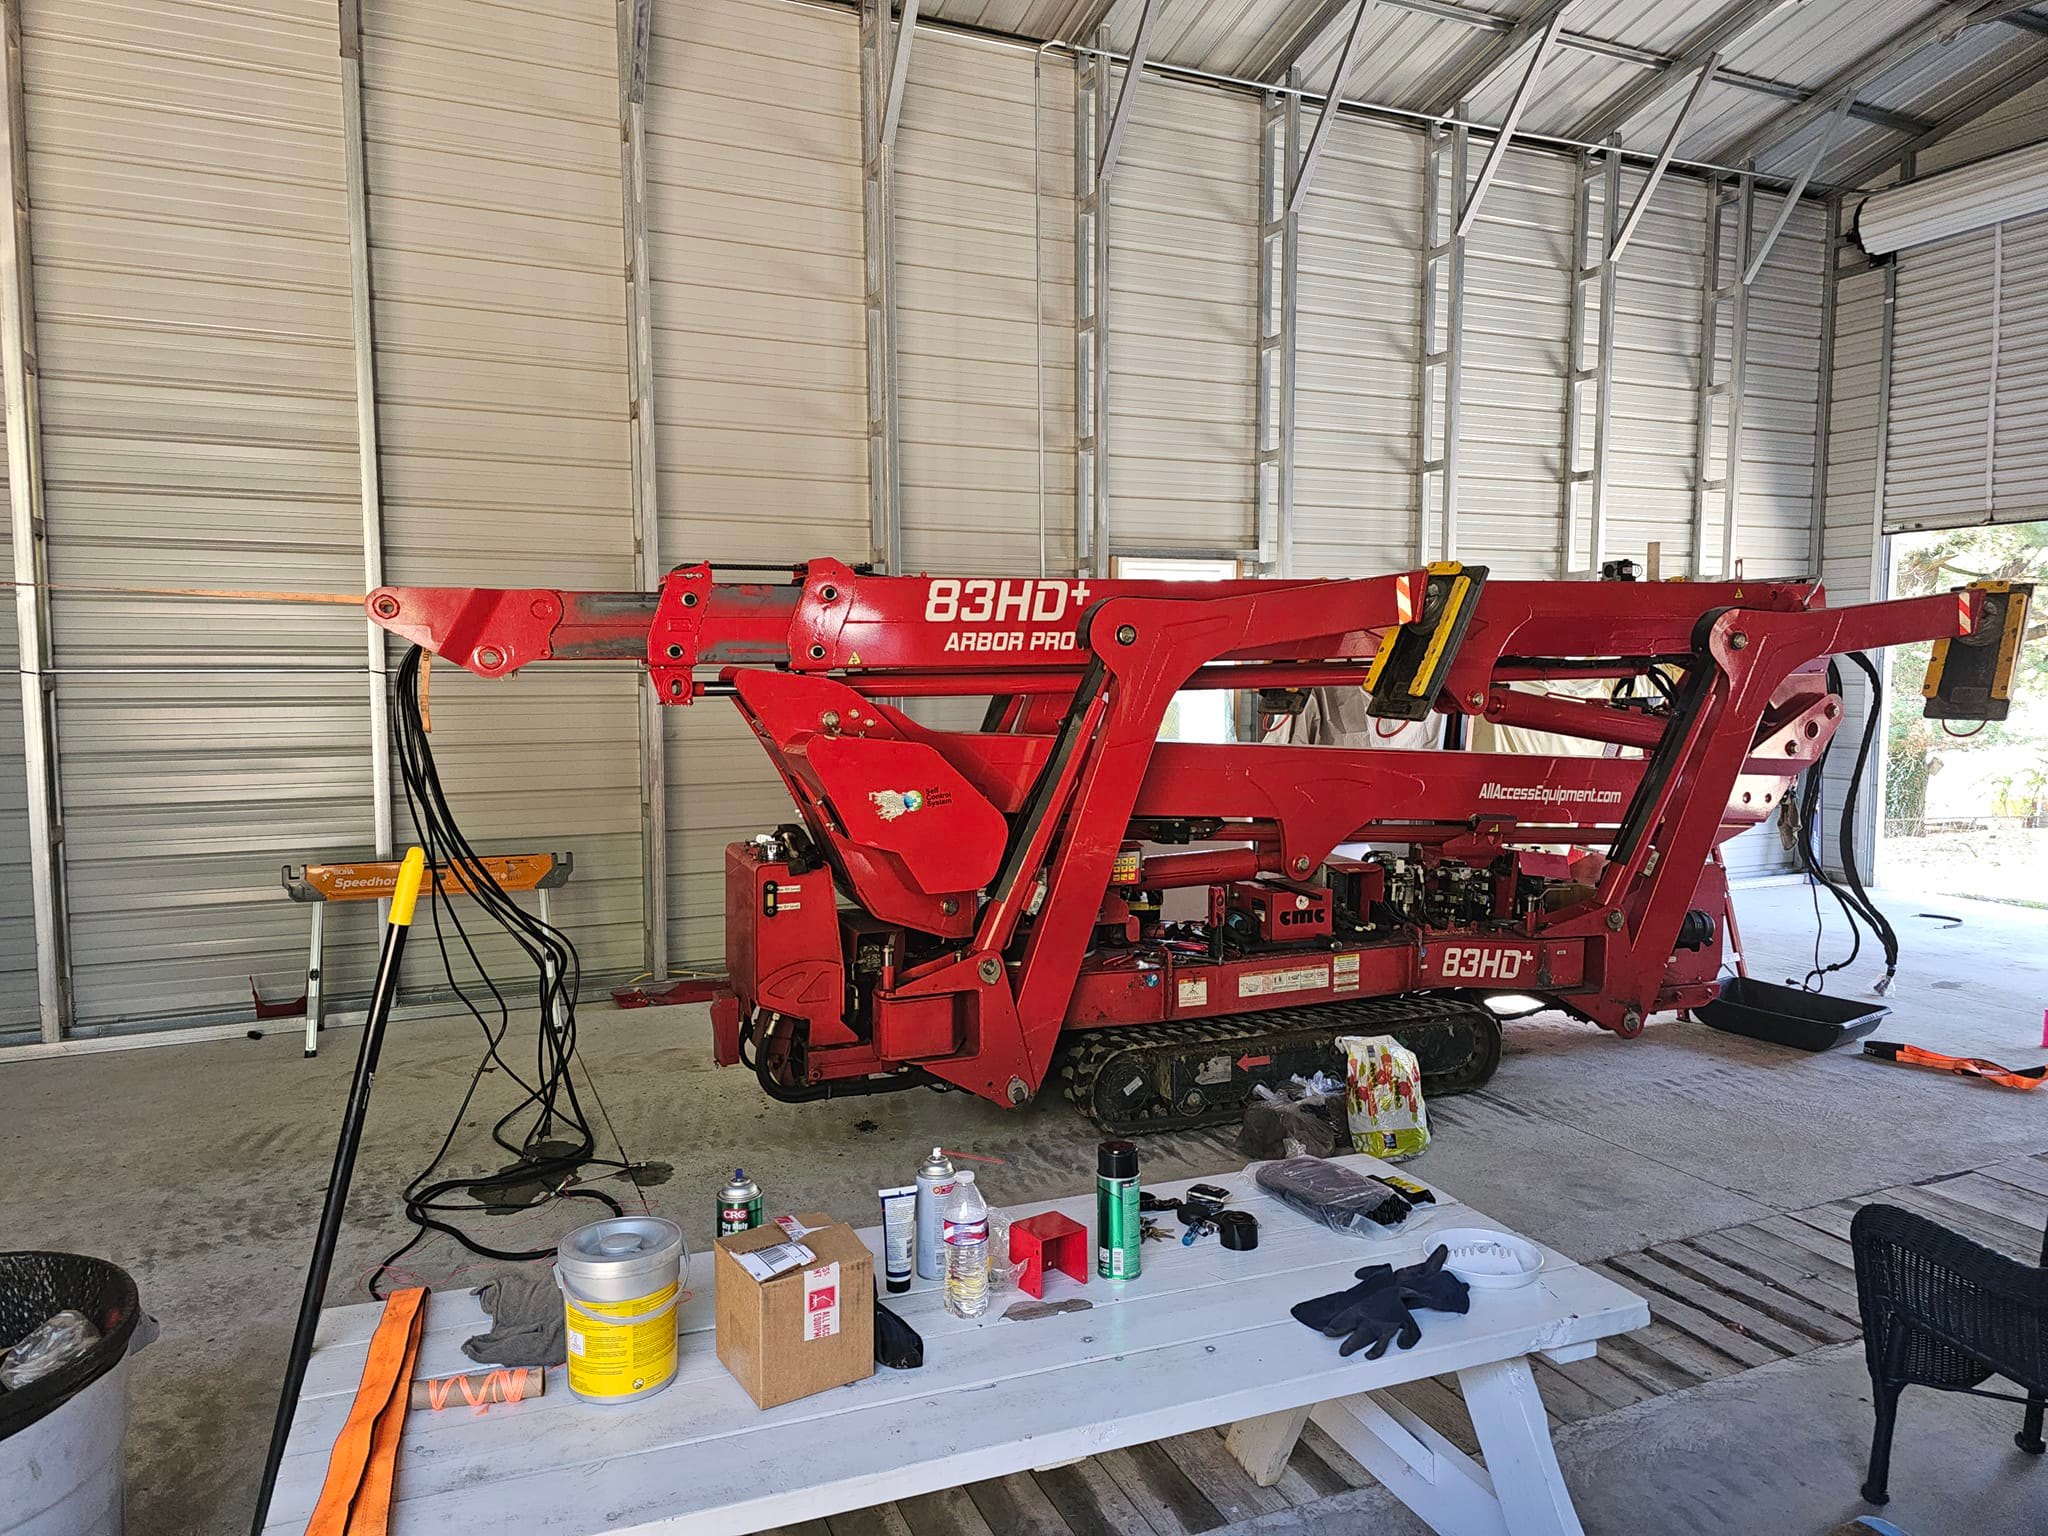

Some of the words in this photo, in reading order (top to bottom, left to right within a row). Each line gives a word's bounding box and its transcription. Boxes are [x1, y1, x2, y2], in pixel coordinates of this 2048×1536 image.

[944, 632, 1024, 652] ARBOR
[1029, 632, 1075, 651] PRO
[926, 792, 952, 800] Control
[1478, 783, 1622, 805] AllAccessEquipment.com
[926, 799, 952, 807] System
[334, 876, 398, 889] Speedhor
[723, 1210, 747, 1219] CRC
[722, 1221, 732, 1231] Dry
